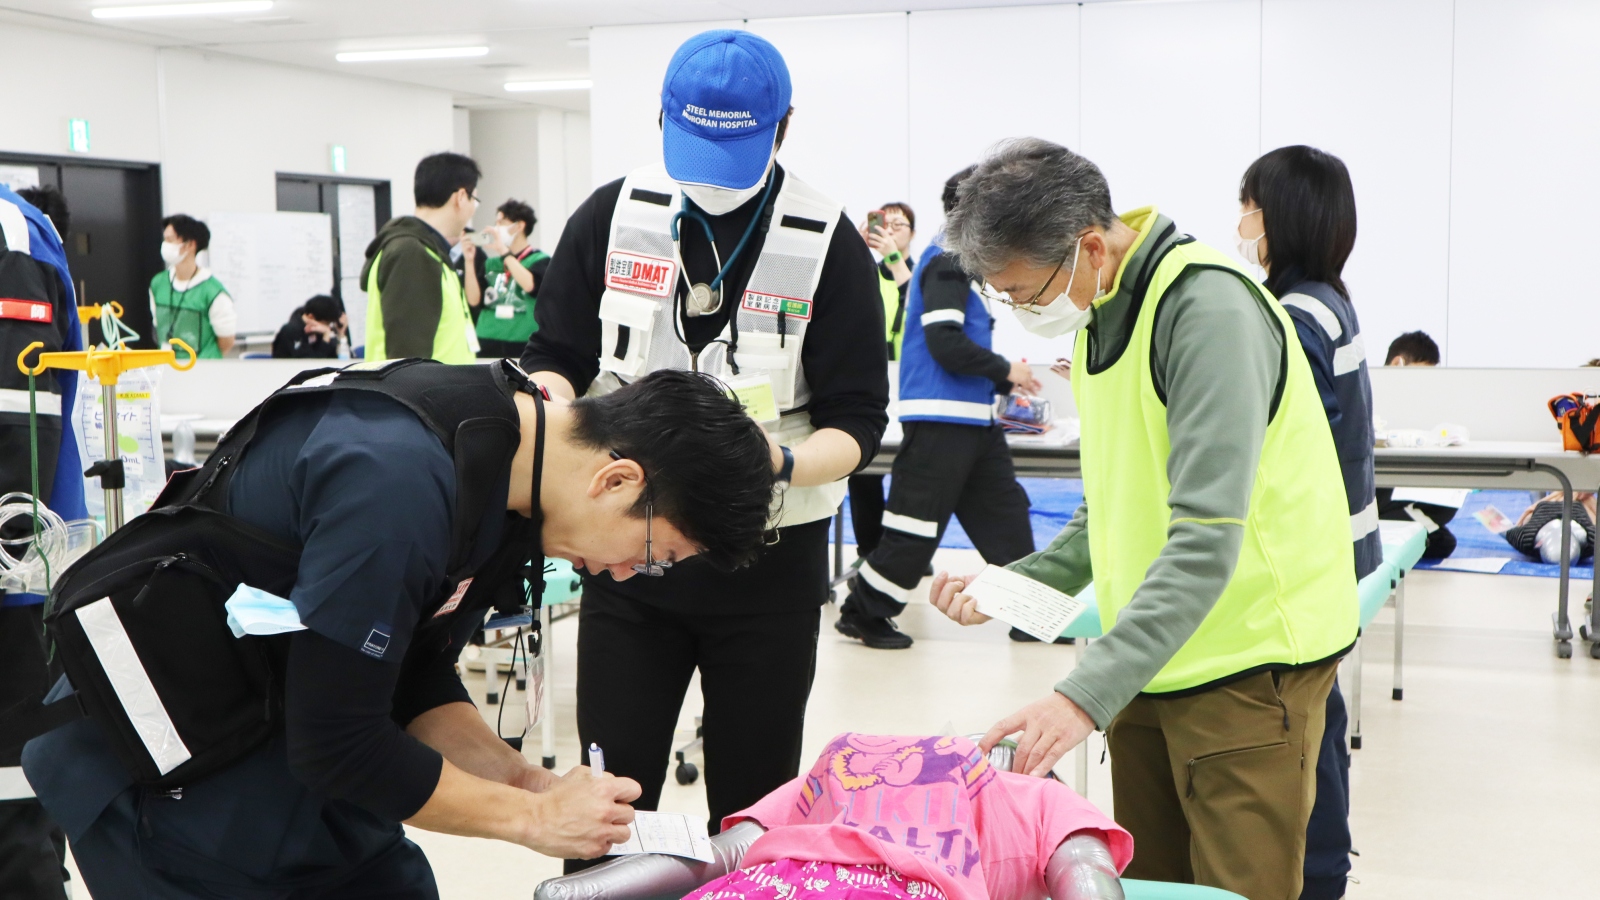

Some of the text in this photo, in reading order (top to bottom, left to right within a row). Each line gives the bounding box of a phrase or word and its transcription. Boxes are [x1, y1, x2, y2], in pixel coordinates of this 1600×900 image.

[686, 103, 752, 119] STEEL MEMORIAL
[719, 118, 758, 129] HOSPITAL
[632, 262, 669, 284] DMAT
